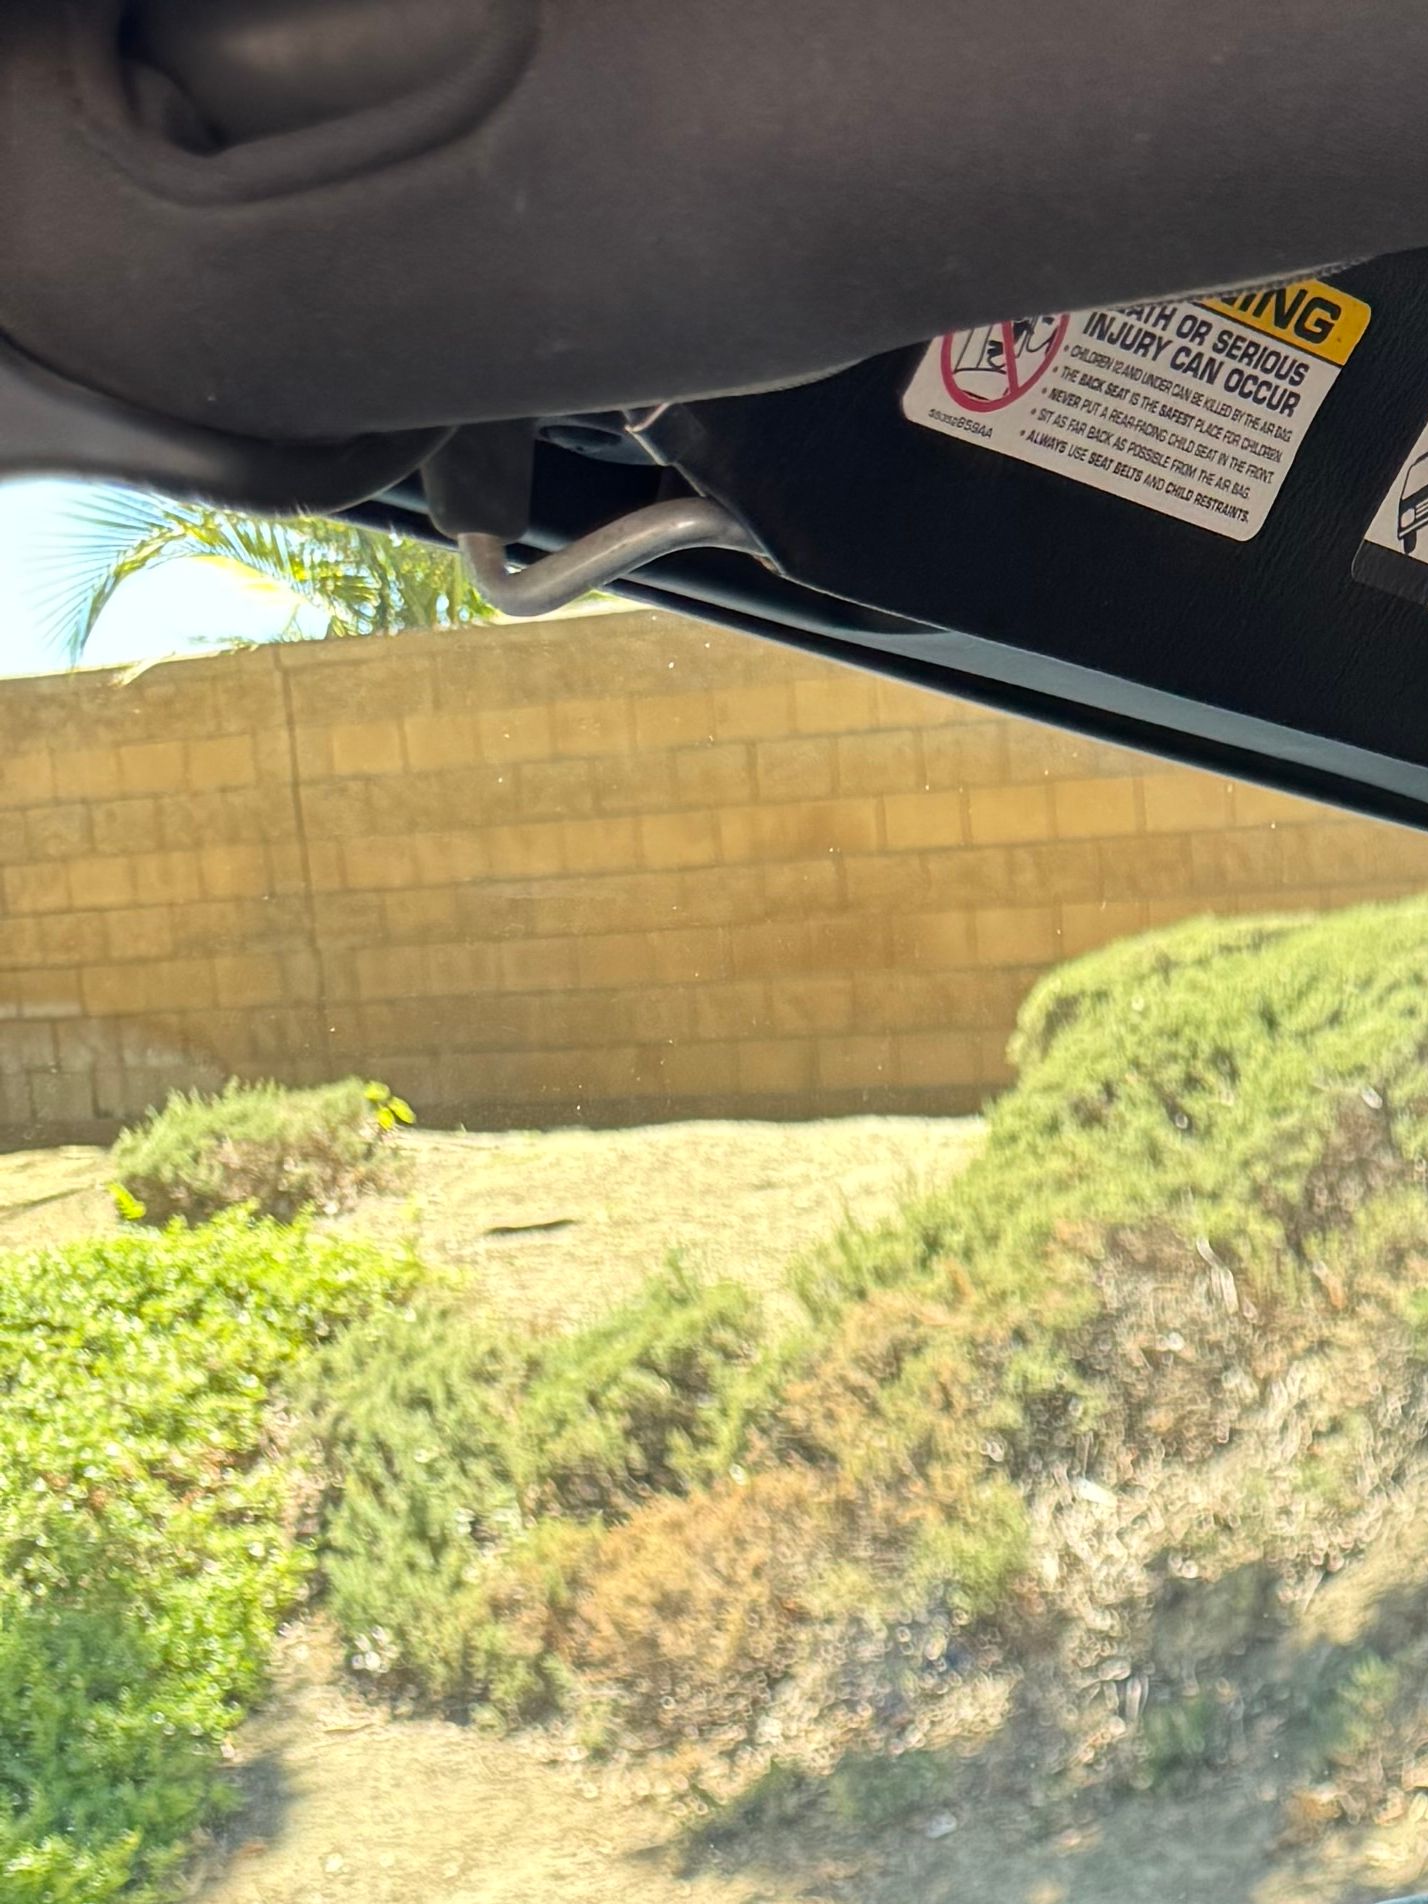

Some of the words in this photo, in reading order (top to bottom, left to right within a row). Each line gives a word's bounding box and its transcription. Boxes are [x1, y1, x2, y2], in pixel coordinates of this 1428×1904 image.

[1070, 344, 1115, 371] CHILDREN
[1121, 366, 1143, 382] AND
[1142, 370, 1173, 394] UNDER
[1171, 383, 1193, 402] CAN
[1190, 391, 1205, 407] BE
[1202, 397, 1233, 418] KILLED
[1231, 408, 1246, 423] BY
[1244, 413, 1262, 431] THE
[1082, 311, 1173, 363] INJURY
[1169, 346, 1226, 387] CAN
[1223, 368, 1303, 418] OCCUR
[1176, 313, 1214, 347] OR
[1211, 329, 1311, 388] SERIOUS
[1048, 387, 1083, 409] NEVER
[1080, 398, 1102, 417] PUT
[1099, 406, 1110, 420] A
[1108, 408, 1169, 443] REAR-FACING
[1167, 432, 1195, 454] CHILD
[1193, 443, 1218, 462] SEAT
[1216, 452, 1231, 467] IN
[1228, 456, 1247, 474] THE
[1060, 365, 1079, 383] THE
[1078, 373, 1107, 393] BACK
[1104, 382, 1132, 401] SEAT
[1128, 391, 1142, 406] IS
[1139, 395, 1161, 414] THE
[1158, 403, 1196, 428] SAFEST
[1193, 418, 1225, 440] PLACE
[1222, 430, 1242, 447] FOR
[1025, 429, 1069, 454] ALWAYS
[1067, 443, 1089, 462] USE
[1087, 451, 1115, 472] SEAT
[1112, 461, 1144, 483] BELTS
[1142, 473, 1166, 491] AND
[1164, 481, 1195, 502] CHILD
[1037, 408, 1055, 425] SIT
[1053, 413, 1068, 429] AS
[1066, 418, 1088, 436] FAR
[1086, 425, 1115, 446] BACK
[1112, 436, 1128, 452] AS
[1126, 441, 1171, 469] POSSIBLE
[1170, 458, 1199, 480] FROM
[1197, 467, 1217, 487] THE
